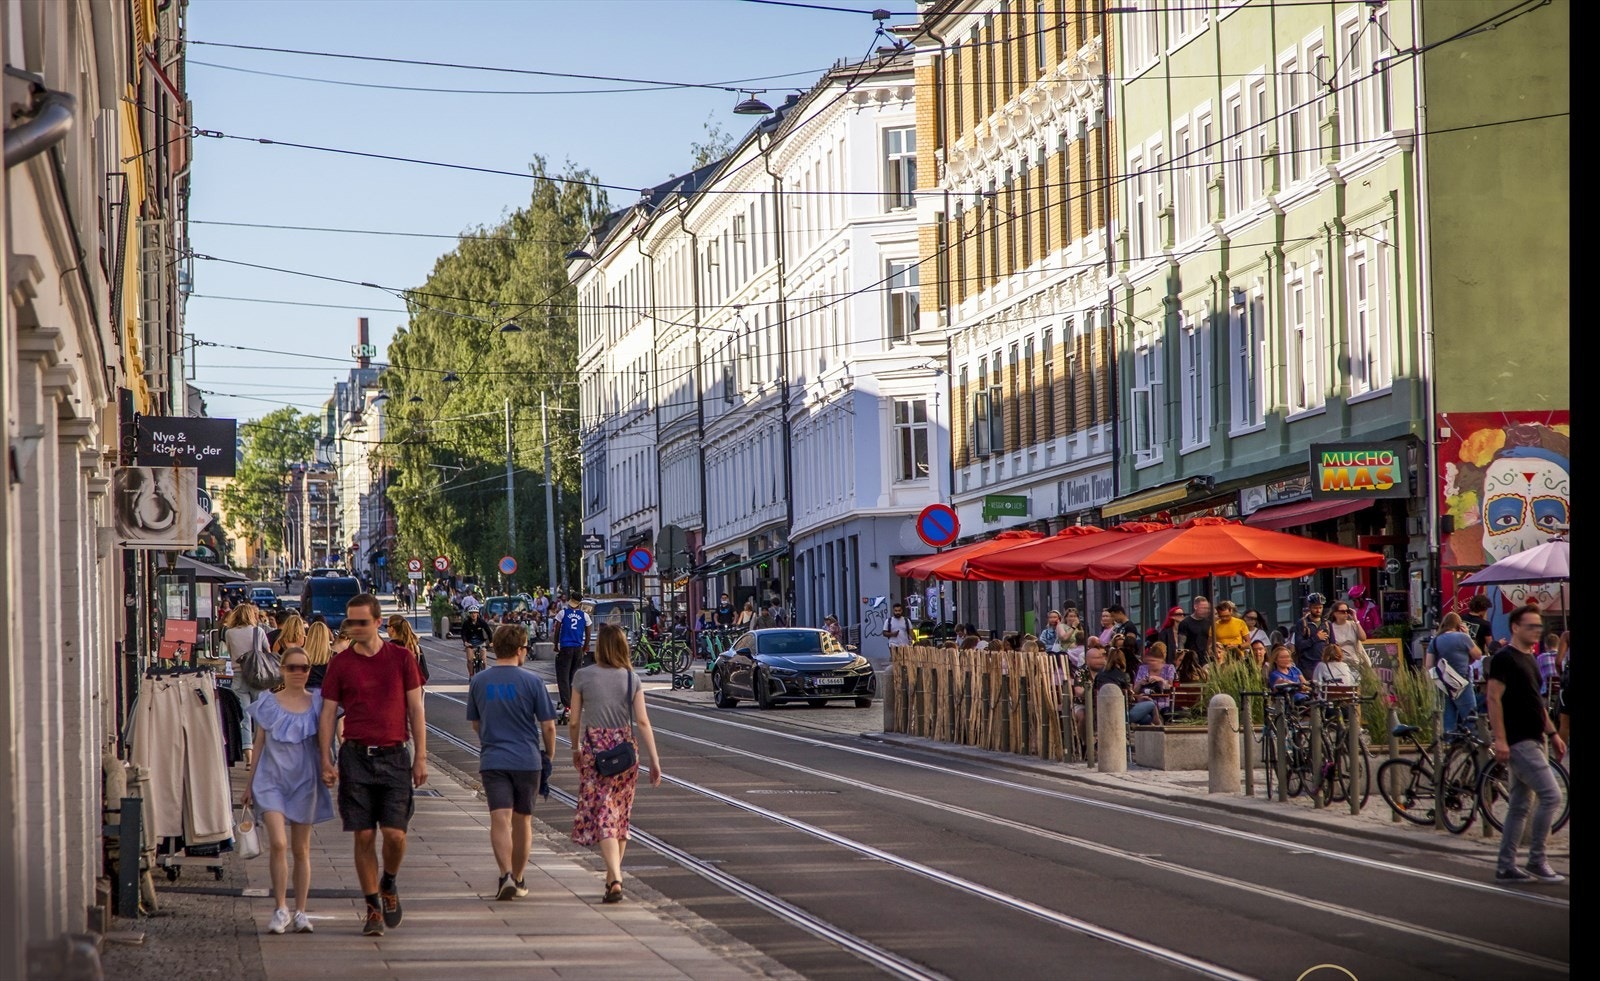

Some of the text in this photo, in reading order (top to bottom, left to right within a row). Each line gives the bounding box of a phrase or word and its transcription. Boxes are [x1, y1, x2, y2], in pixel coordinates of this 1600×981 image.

[153, 431, 187, 443] Nye &
[1323, 451, 1393, 467] MUCHO
[1321, 467, 1394, 491] MAS
[570, 618, 578, 630] 2
[1365, 647, 1381, 657] Try
